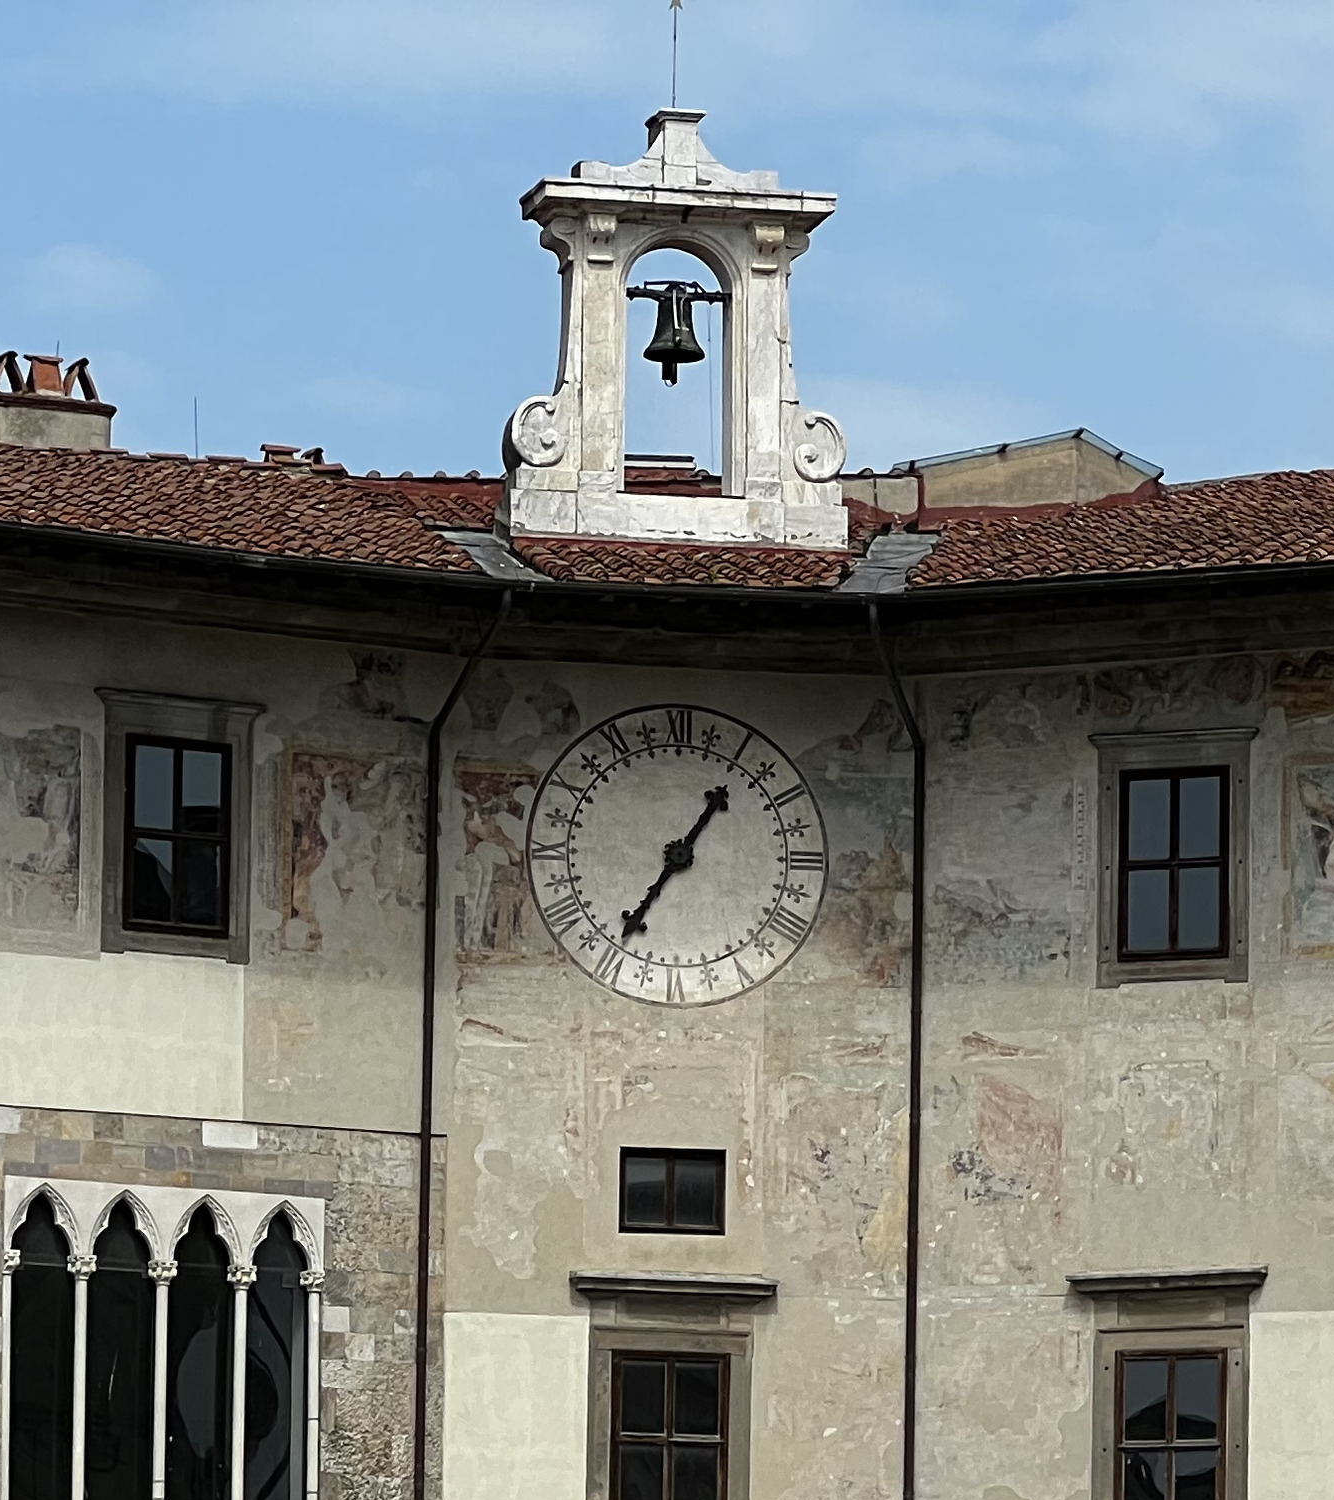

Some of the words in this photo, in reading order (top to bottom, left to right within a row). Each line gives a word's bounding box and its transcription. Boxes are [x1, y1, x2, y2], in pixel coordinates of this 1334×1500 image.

[598, 722, 630, 760] XI
[666, 710, 693, 744] XII
[549, 771, 585, 800] X
